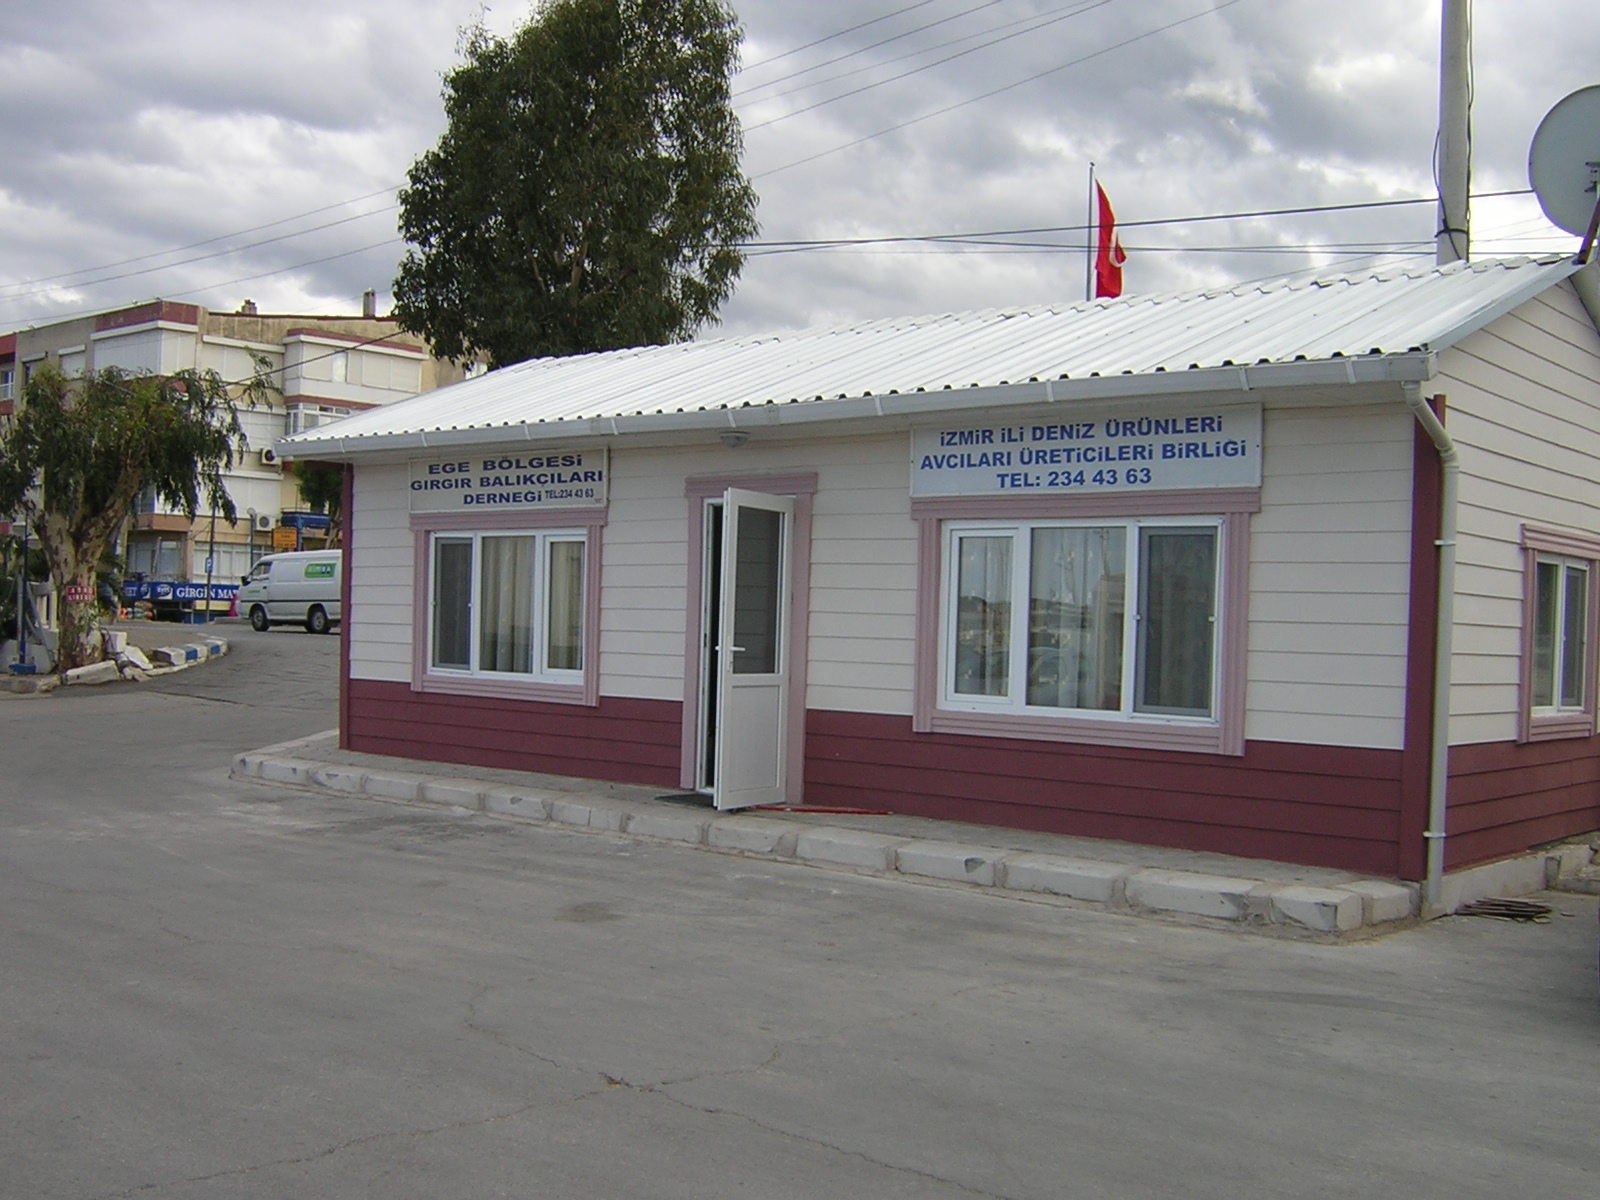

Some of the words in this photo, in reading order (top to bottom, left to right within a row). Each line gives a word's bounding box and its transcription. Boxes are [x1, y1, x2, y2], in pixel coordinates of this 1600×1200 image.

[428, 461, 471, 475] EGE
[920, 451, 1011, 470] AVCILARI
[410, 478, 472, 491] GIRGIR
[479, 470, 604, 487] BALIKÇILARI
[996, 472, 1041, 488] TEL:
[1047, 470, 1085, 487] 234
[1092, 469, 1118, 485] 43
[1125, 467, 1152, 484] 63
[574, 488, 584, 498] 43
[585, 488, 594, 498] 63
